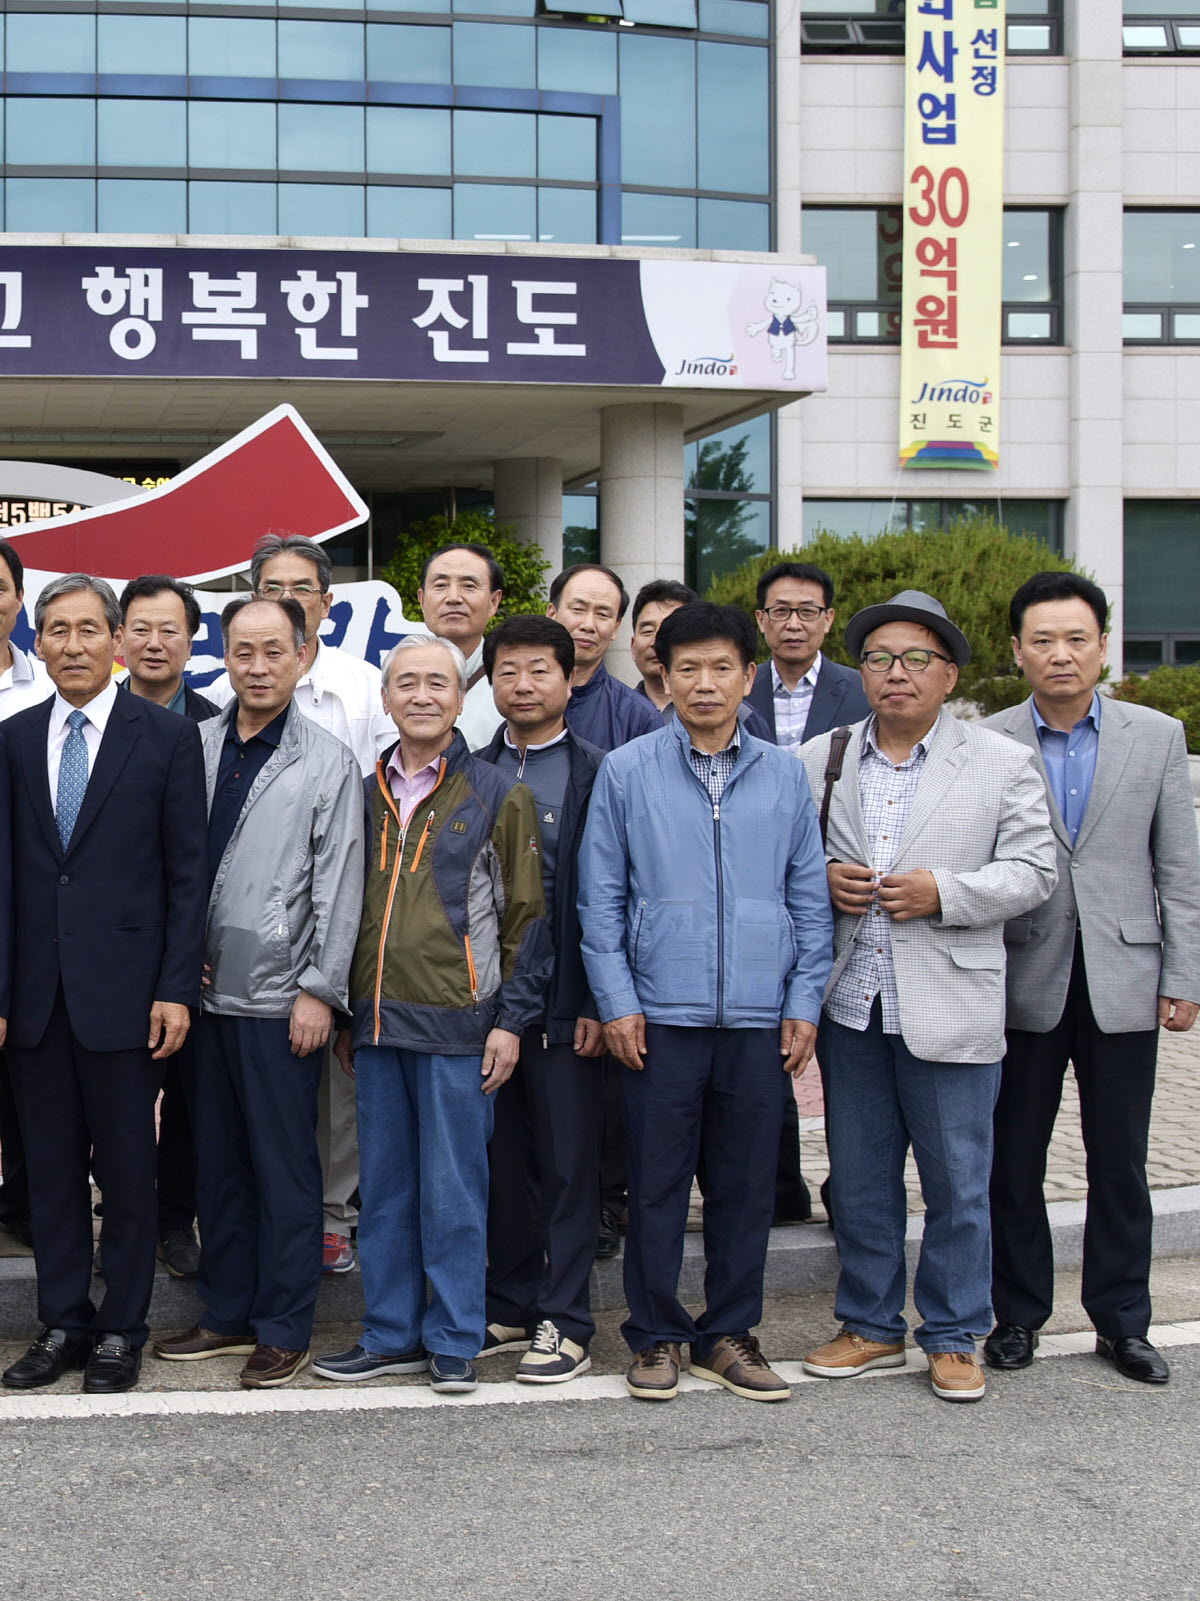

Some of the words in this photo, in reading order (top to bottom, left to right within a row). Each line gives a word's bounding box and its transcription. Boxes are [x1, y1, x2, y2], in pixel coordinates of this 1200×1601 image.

[971, 28, 998, 96] 선정
[908, 165, 970, 349] 30억원
[81, 266, 369, 361] 행복한
[412, 274, 587, 363] 진도
[675, 358, 728, 376] Jindo
[911, 382, 981, 404] Jindo
